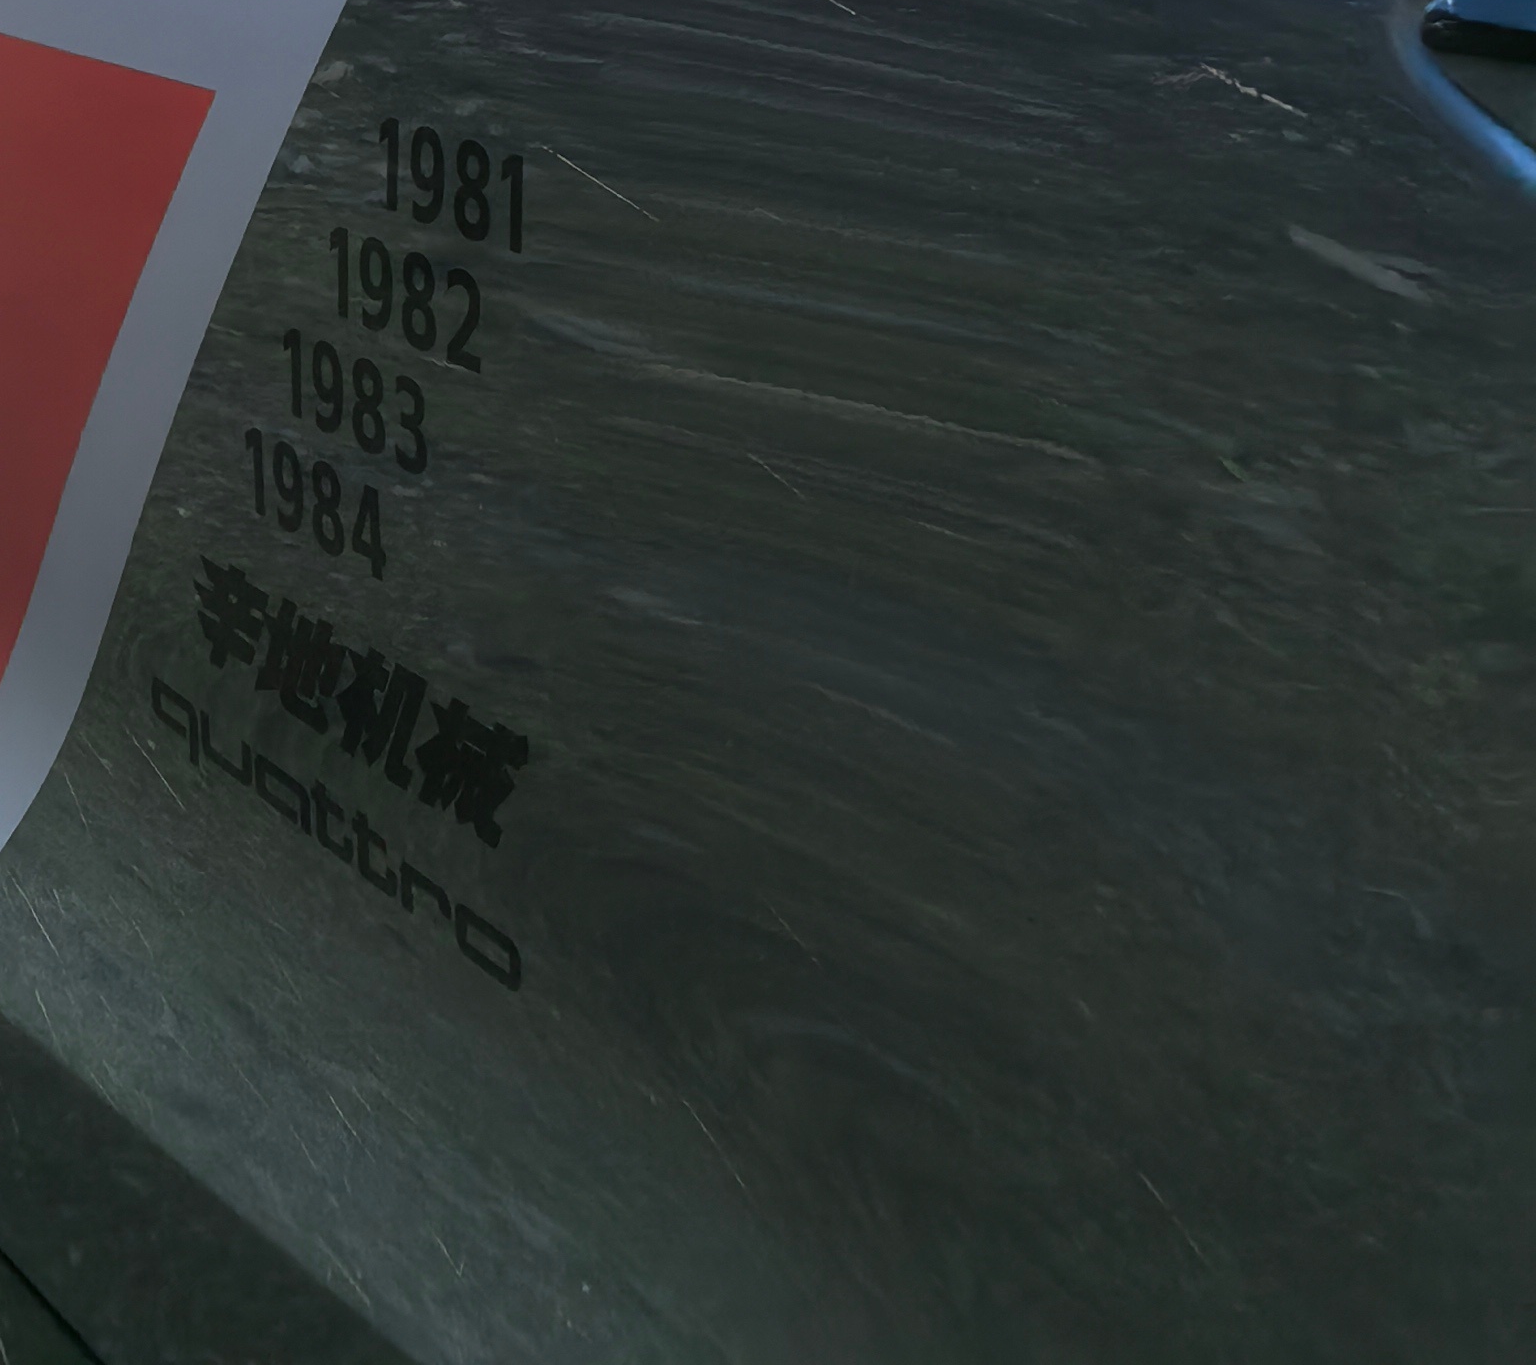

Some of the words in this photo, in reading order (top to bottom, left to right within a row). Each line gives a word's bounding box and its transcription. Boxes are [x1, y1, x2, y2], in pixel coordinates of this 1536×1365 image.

[378, 117, 525, 254] 1981
[329, 225, 482, 374] 1982
[282, 328, 428, 475] 1983
[244, 427, 387, 581] 1984
[150, 676, 522, 993] quattro
